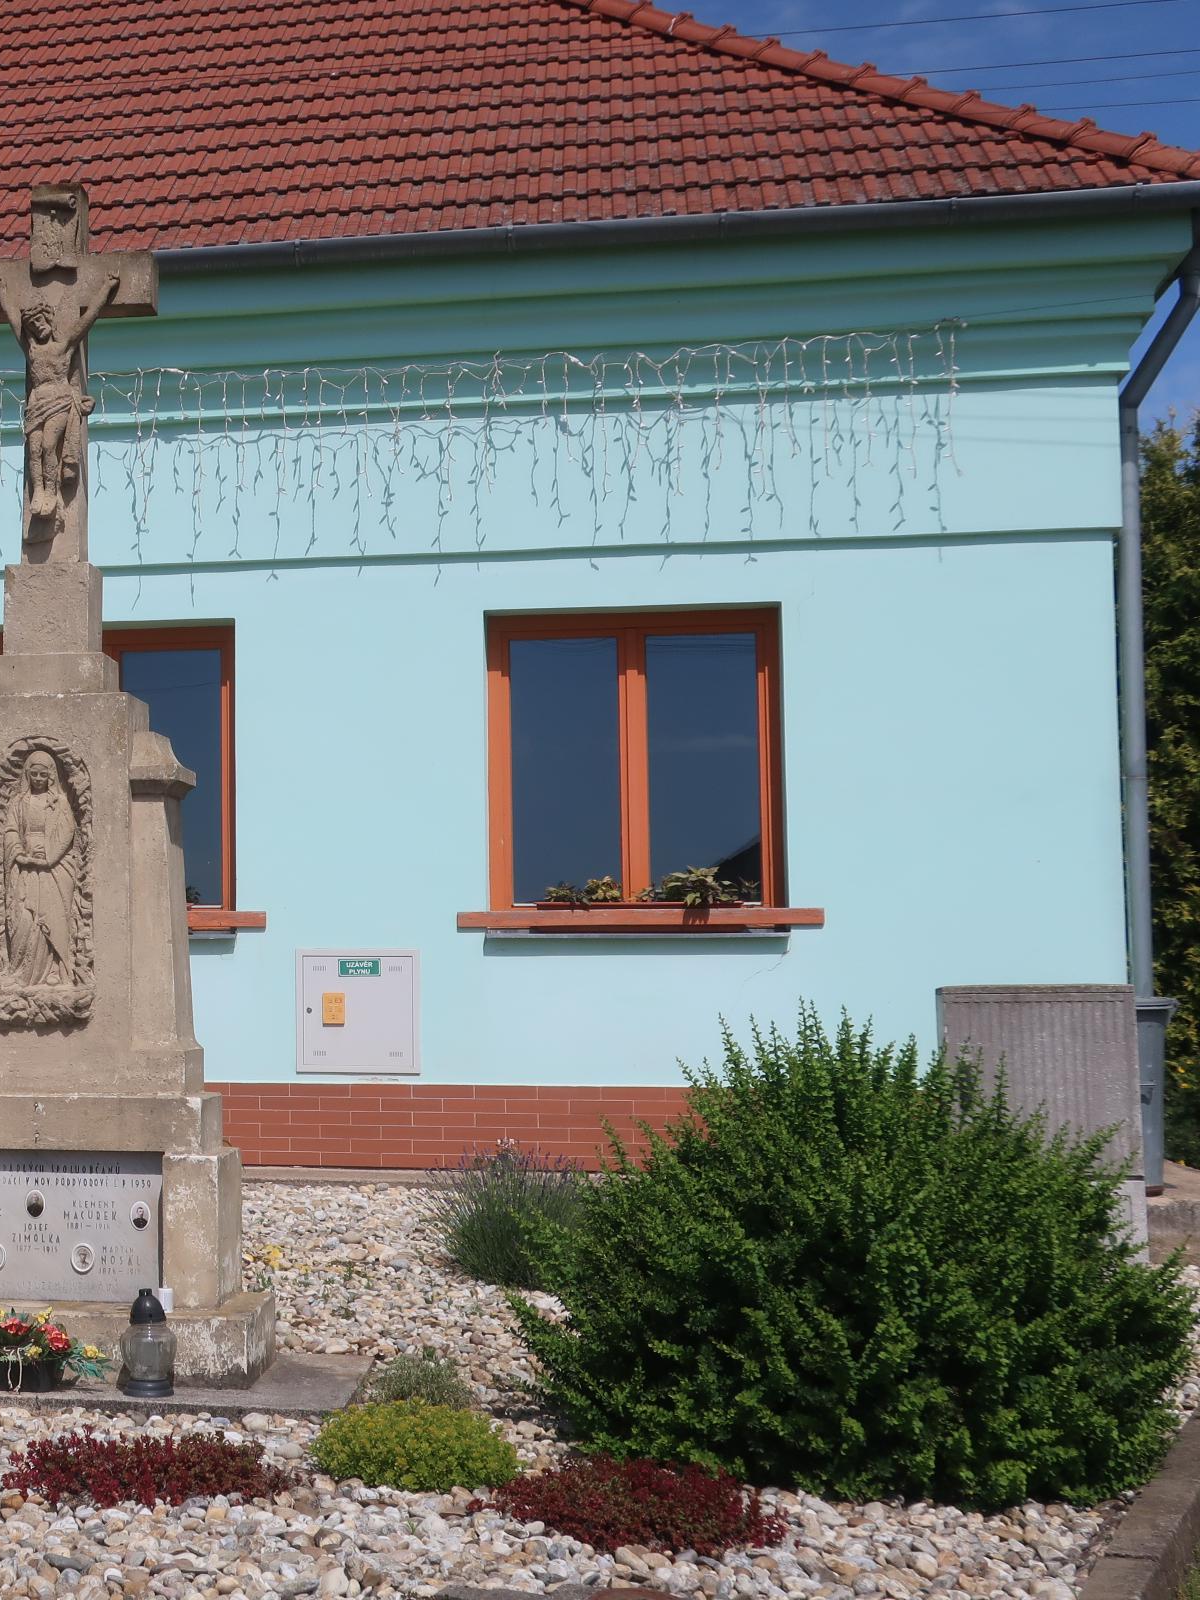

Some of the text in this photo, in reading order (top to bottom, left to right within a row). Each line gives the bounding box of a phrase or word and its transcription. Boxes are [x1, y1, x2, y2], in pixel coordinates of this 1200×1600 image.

[348, 968, 371, 976] PLYNU
[72, 1200, 116, 1209] KLEMENT
[63, 1211, 118, 1221] MACUREK
[23, 1223, 48, 1233] JOSEF
[11, 1232, 60, 1244] ZIMOLKA
